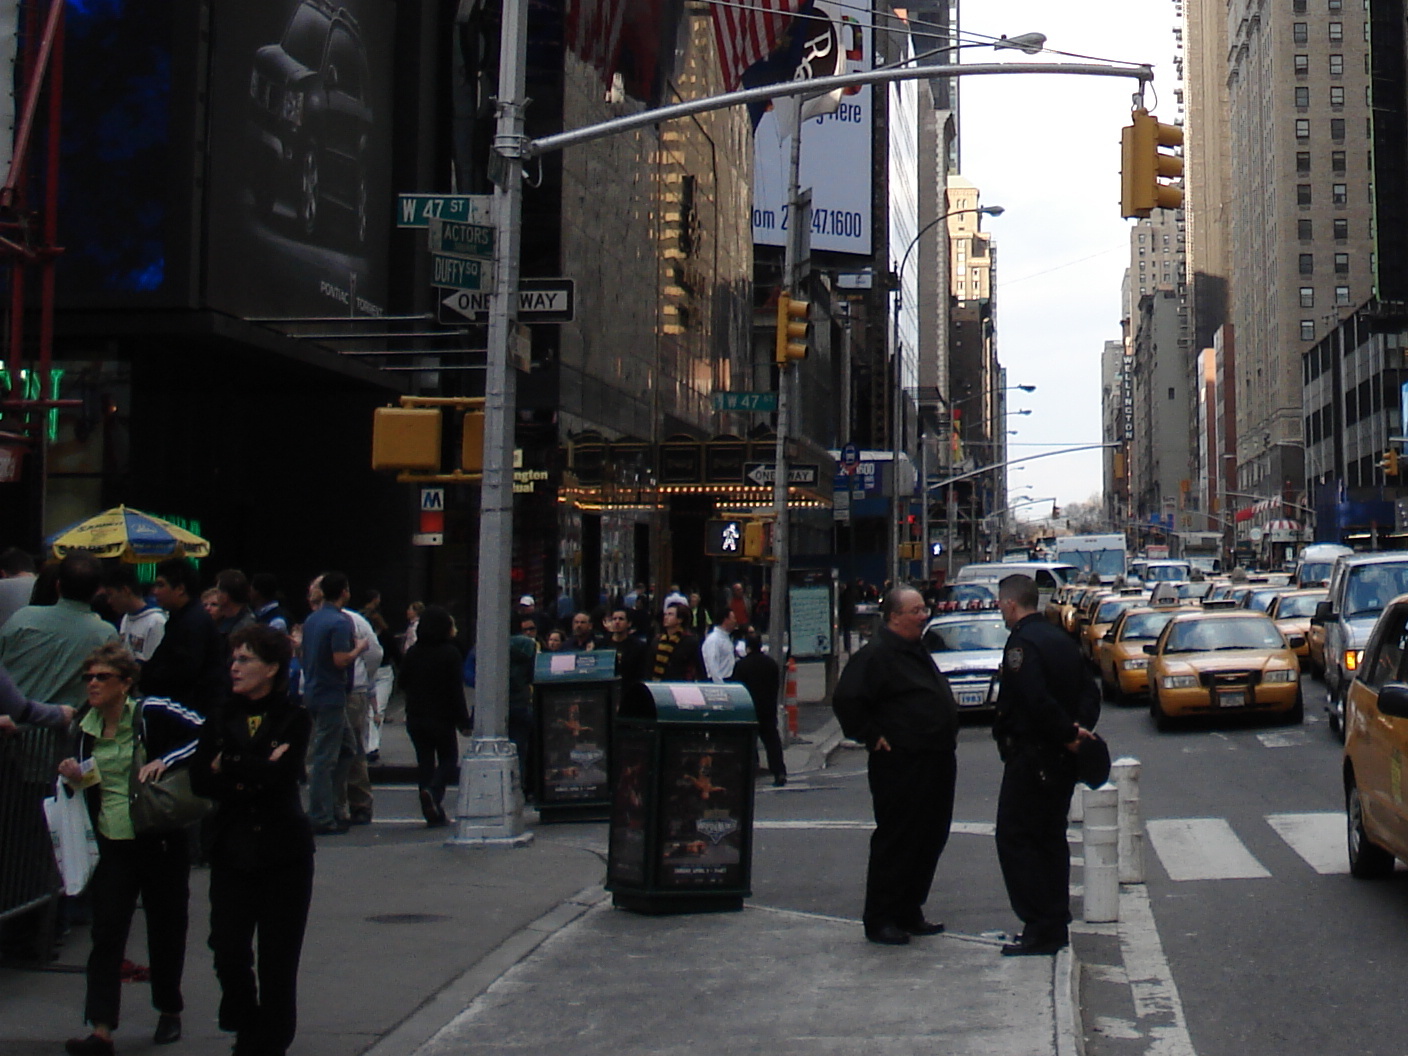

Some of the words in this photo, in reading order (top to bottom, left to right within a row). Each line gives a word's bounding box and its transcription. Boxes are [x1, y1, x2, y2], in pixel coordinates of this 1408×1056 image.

[402, 198, 417, 223] W
[422, 198, 444, 219] 47
[450, 200, 465, 213] ST
[444, 225, 490, 245] ACTORS
[434, 257, 466, 284] DUFFY
[466, 262, 478, 275] SQ
[320, 280, 349, 304] PONTIAC
[458, 294, 491, 310] ONE
[519, 293, 559, 309] WAY
[741, 395, 759, 409] 47
[1123, 356, 1134, 439] WELLINGTON
[755, 469, 776, 480] ONE
